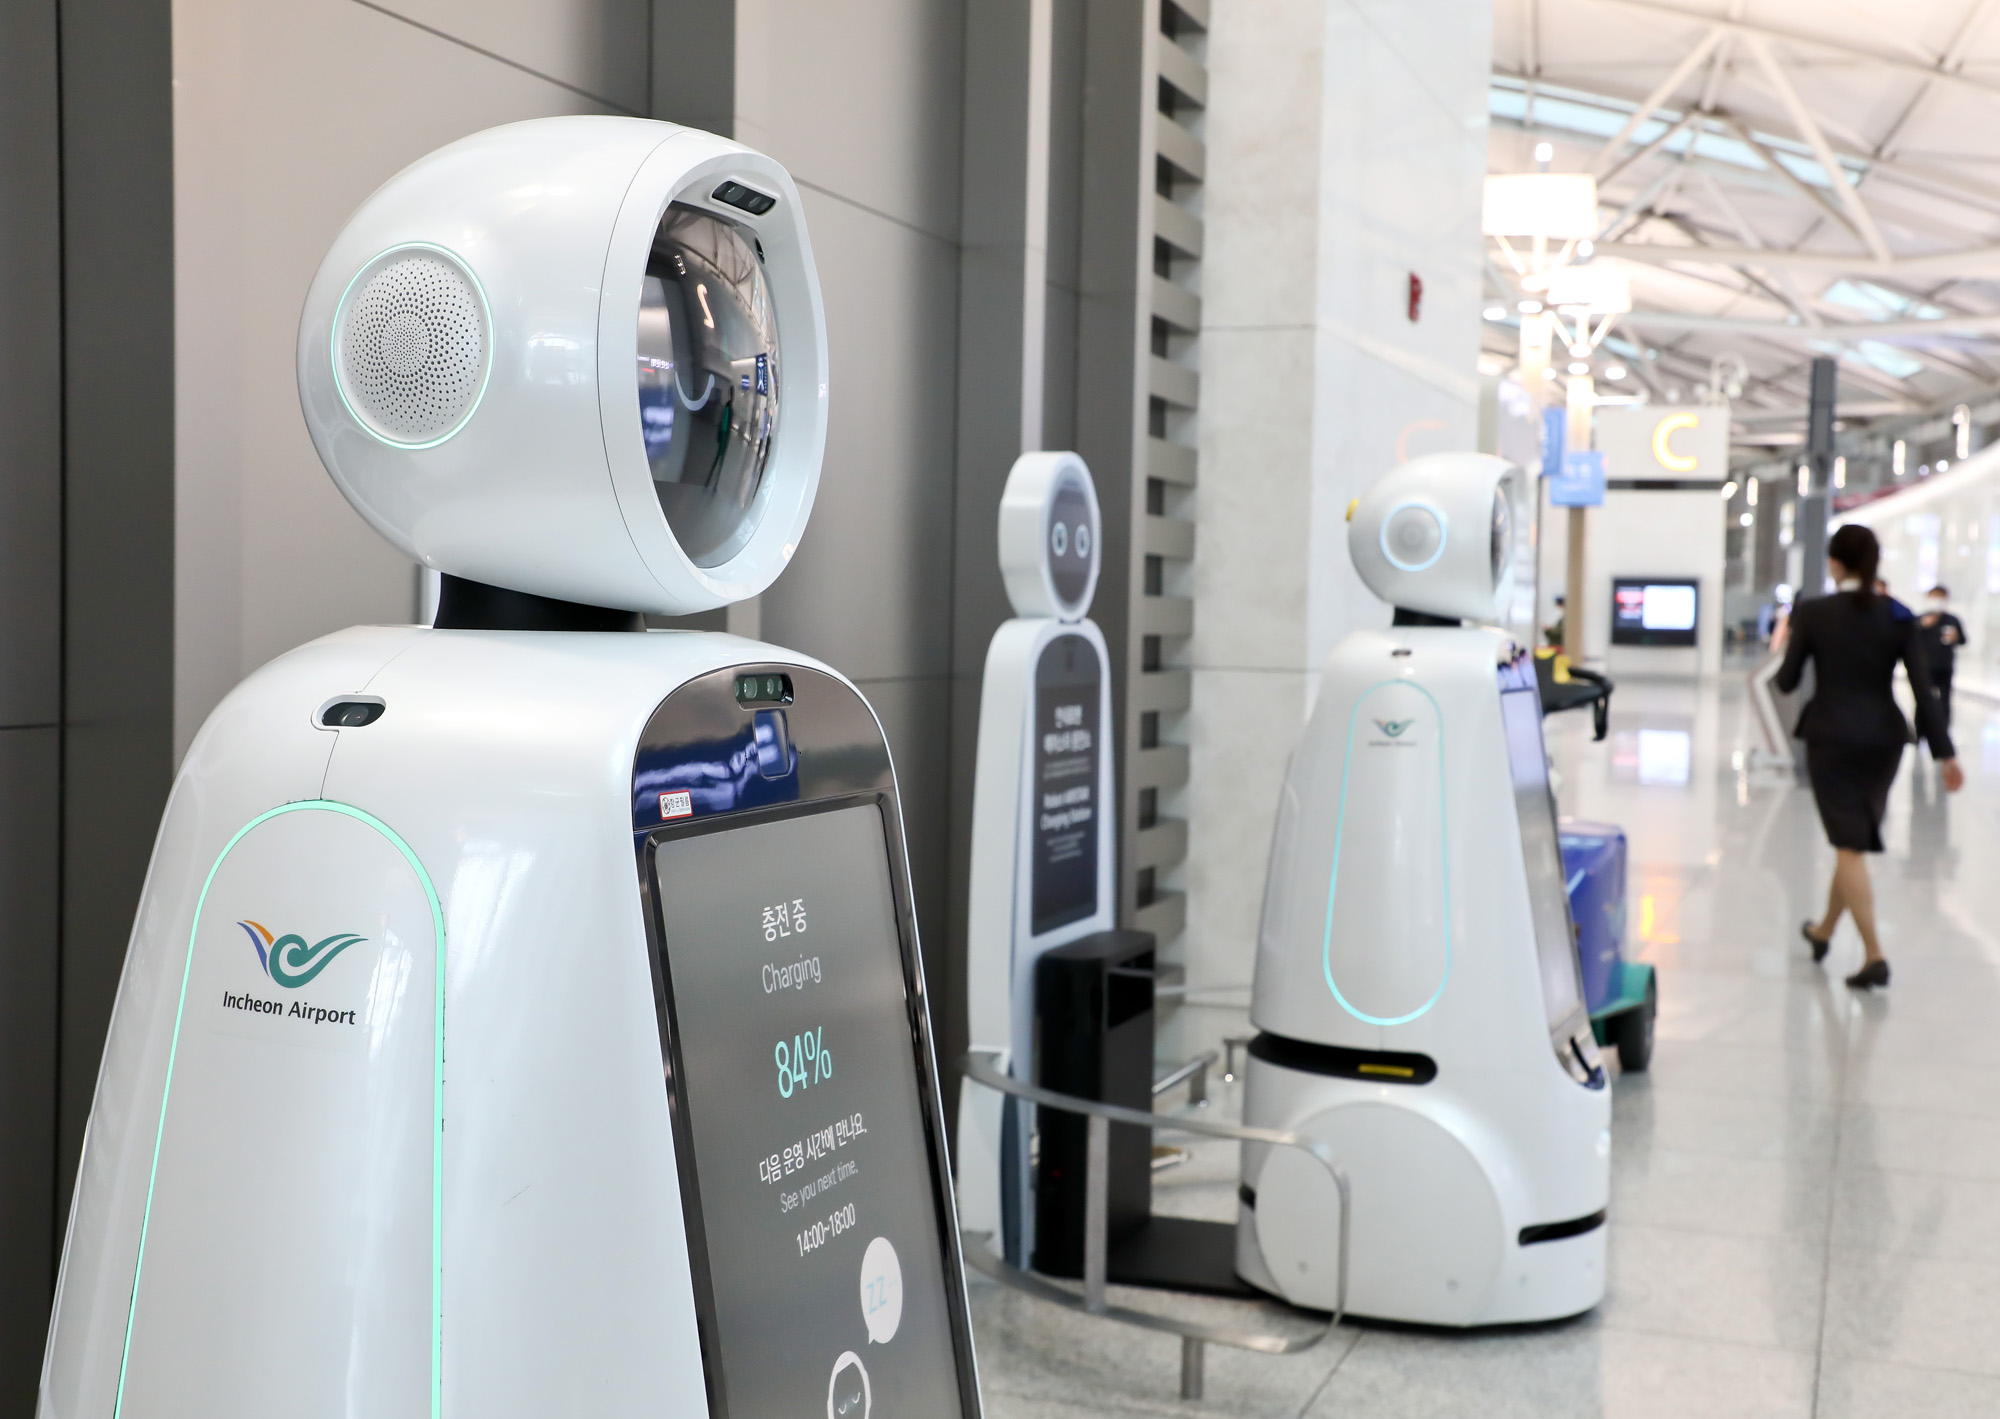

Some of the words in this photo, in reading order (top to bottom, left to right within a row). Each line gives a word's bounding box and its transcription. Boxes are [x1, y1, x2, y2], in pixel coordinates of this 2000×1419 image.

[1652, 412, 1699, 471] C
[762, 902, 791, 941] 충전
[792, 898, 807, 932] 중
[762, 953, 821, 994] Charging
[223, 991, 283, 1015] Incheon
[288, 1001, 356, 1025] Airport
[775, 1026, 832, 1098] 84%
[759, 1154, 782, 1185] 다음
[783, 1141, 805, 1175] 운영
[806, 1125, 836, 1160] 시간에
[835, 1112, 868, 1147] 만나요.
[780, 1191, 799, 1213] See
[799, 1181, 817, 1207] you
[817, 1167, 837, 1193] next
[837, 1160, 859, 1181] time.
[796, 1203, 856, 1257] 14:00~18:00
